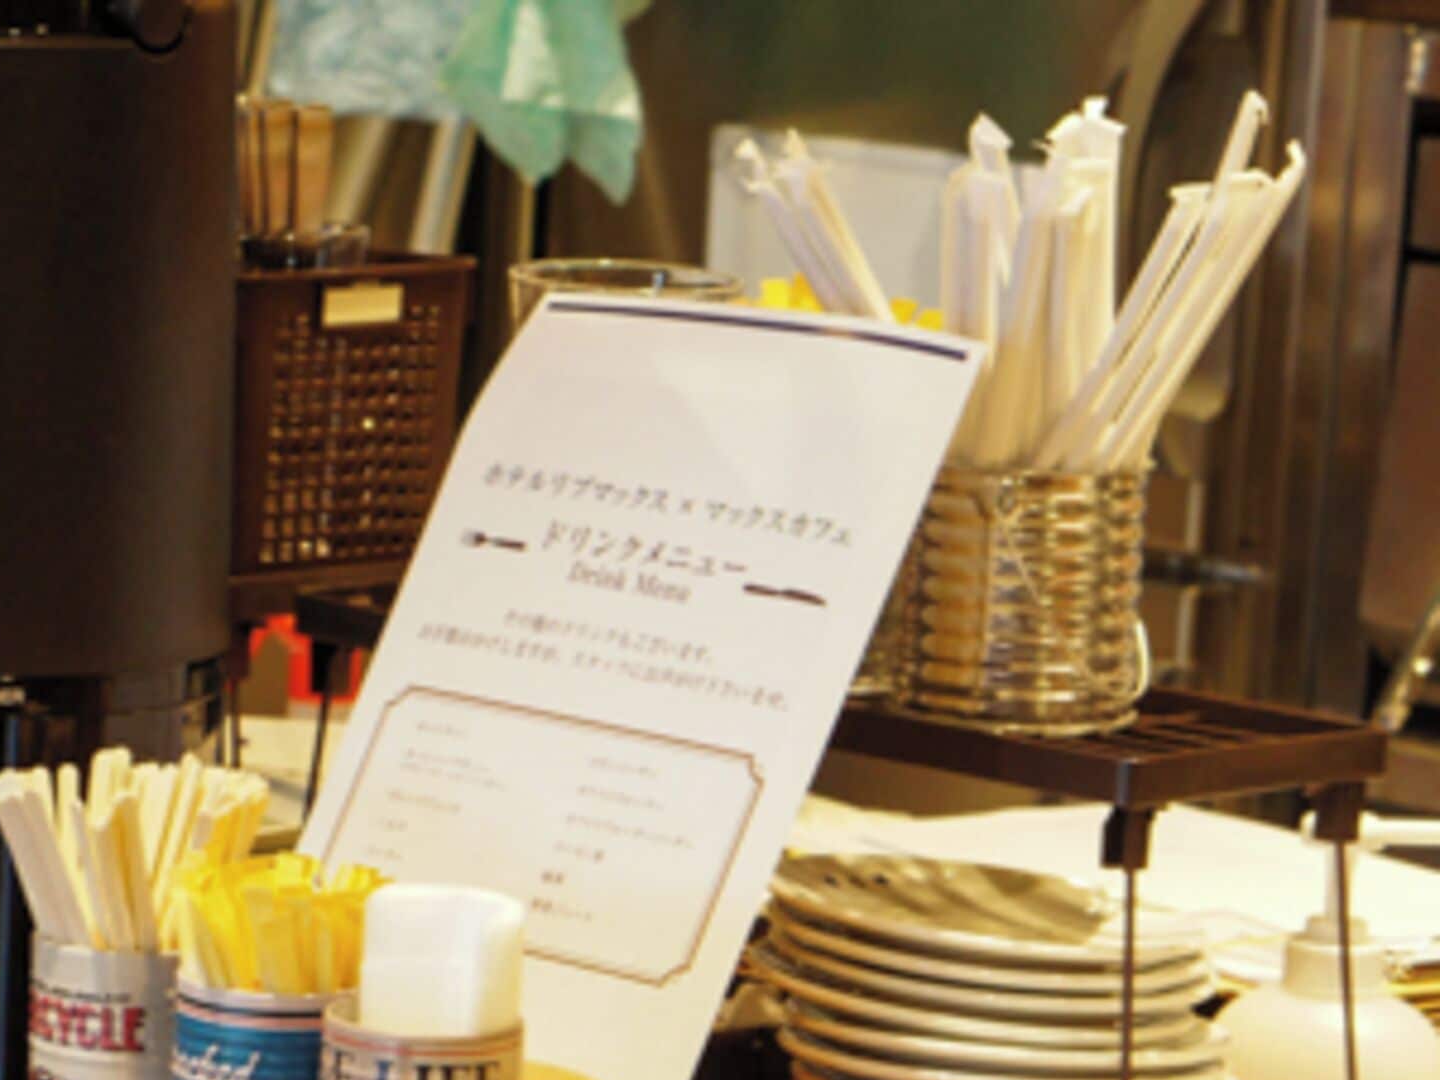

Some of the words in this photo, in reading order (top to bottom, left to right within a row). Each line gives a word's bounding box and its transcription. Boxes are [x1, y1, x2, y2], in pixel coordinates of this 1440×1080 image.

[706, 500, 853, 547] マックスカフェ
[542, 519, 748, 577] ドリンクメニュー
[568, 560, 627, 593] Drink
[635, 572, 693, 604] Menu
